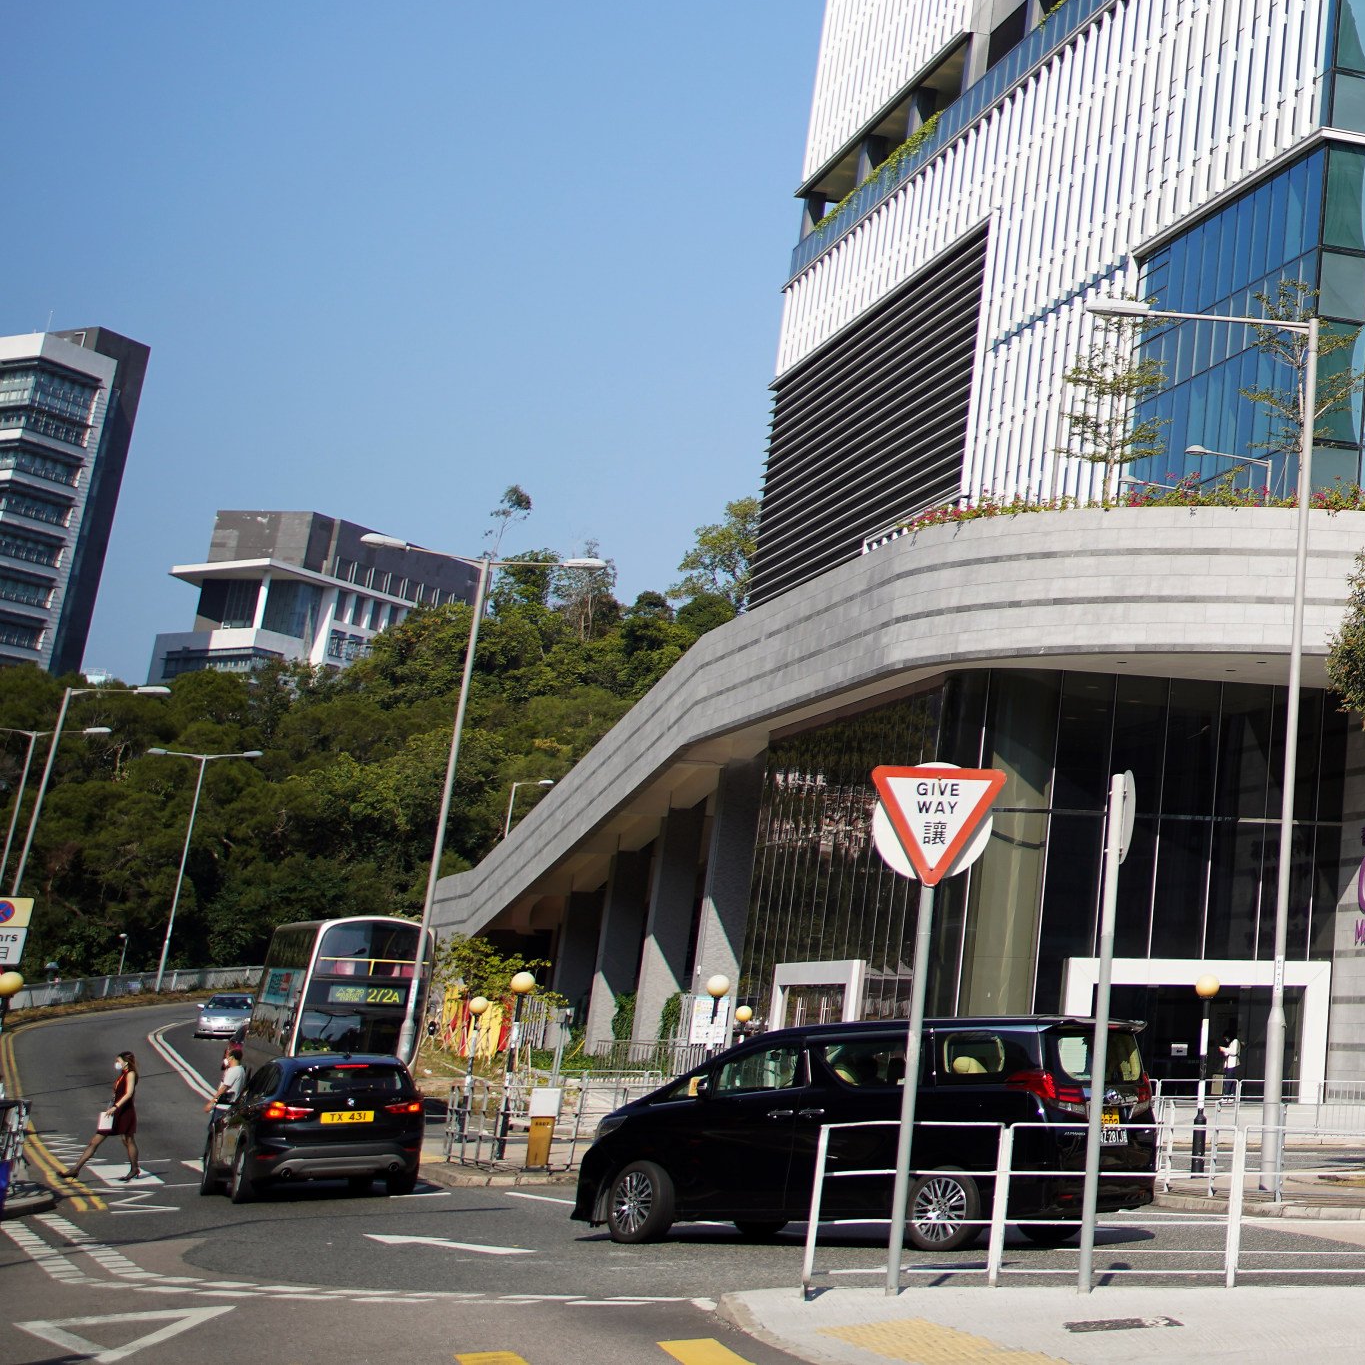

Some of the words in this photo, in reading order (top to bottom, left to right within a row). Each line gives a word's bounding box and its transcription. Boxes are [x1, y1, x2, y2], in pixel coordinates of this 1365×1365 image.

[916, 782, 960, 797] GIVE
[917, 801, 959, 815] WAY
[923, 821, 947, 845] 讓
[330, 1113, 343, 1121] TX
[349, 1112, 367, 1121] 431
